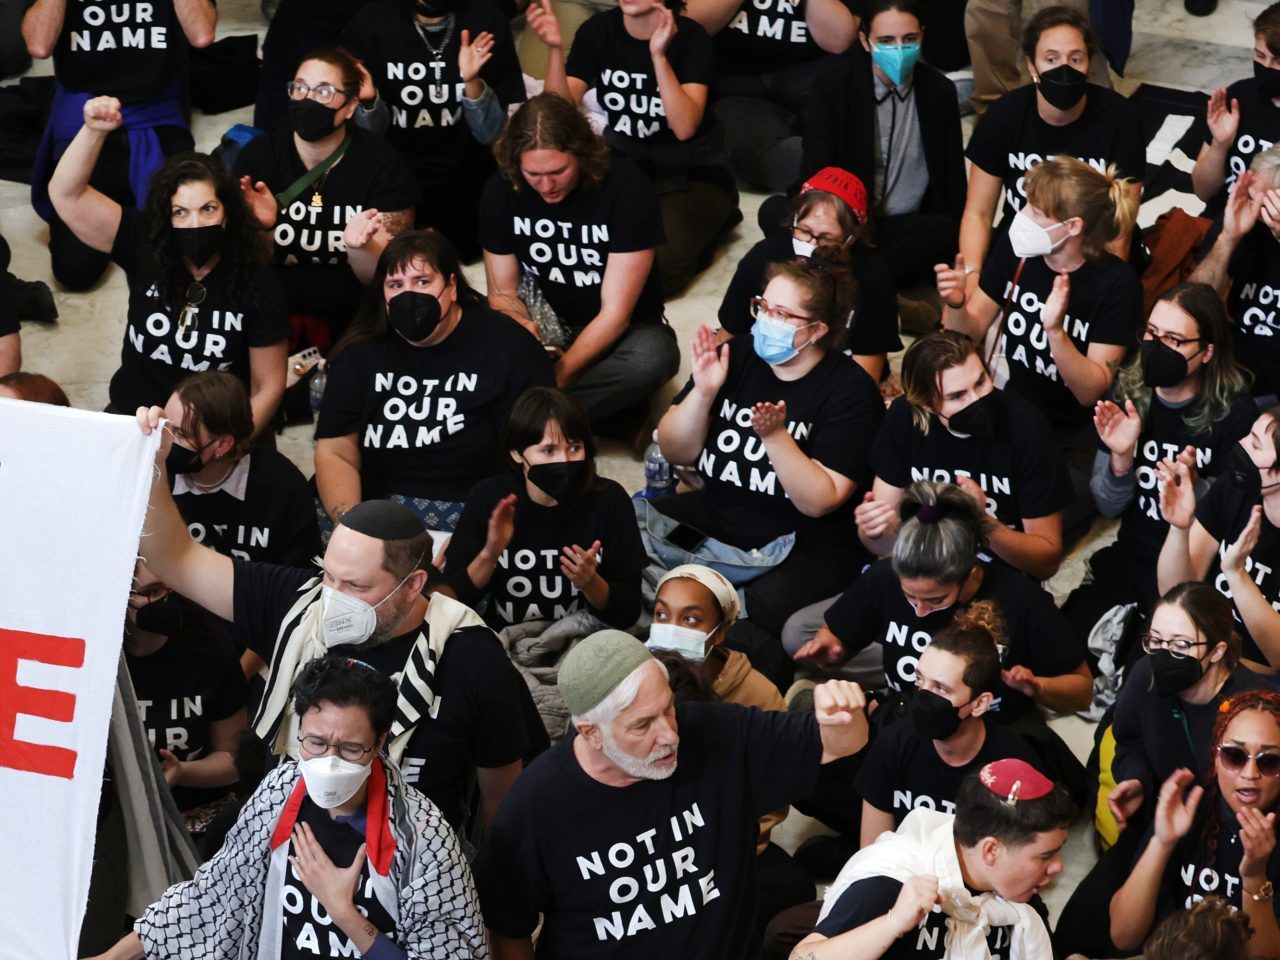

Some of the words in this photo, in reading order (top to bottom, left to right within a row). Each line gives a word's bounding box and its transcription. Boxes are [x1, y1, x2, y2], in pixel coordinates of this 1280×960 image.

[83, 2, 153, 26] OUR
[71, 26, 167, 51] NAME
[387, 61, 446, 80] NOT
[601, 68, 648, 89] NOT
[392, 105, 462, 129] NAM
[604, 92, 666, 117] OUR
[281, 201, 323, 225] OT
[274, 223, 348, 252] OUR
[513, 216, 573, 239] NOT
[581, 224, 610, 244] IN
[529, 242, 603, 267] OUR
[212, 310, 244, 332] IN
[1007, 312, 1048, 350] OU
[1062, 315, 1090, 342] IN
[146, 313, 227, 358] OUR
[375, 372, 439, 397] NOT
[445, 372, 477, 392] IN
[383, 396, 458, 421] OUR
[364, 414, 465, 449] NAME
[717, 428, 767, 462] OU
[698, 448, 780, 497] NAM
[980, 473, 1011, 495] IN
[237, 524, 269, 548] IN
[170, 695, 203, 720] IN
[576, 828, 657, 880] NOT
[670, 802, 705, 842] IN
[609, 846, 699, 904] OUR
[1181, 864, 1242, 897] NOT
[593, 869, 720, 941] NAME
